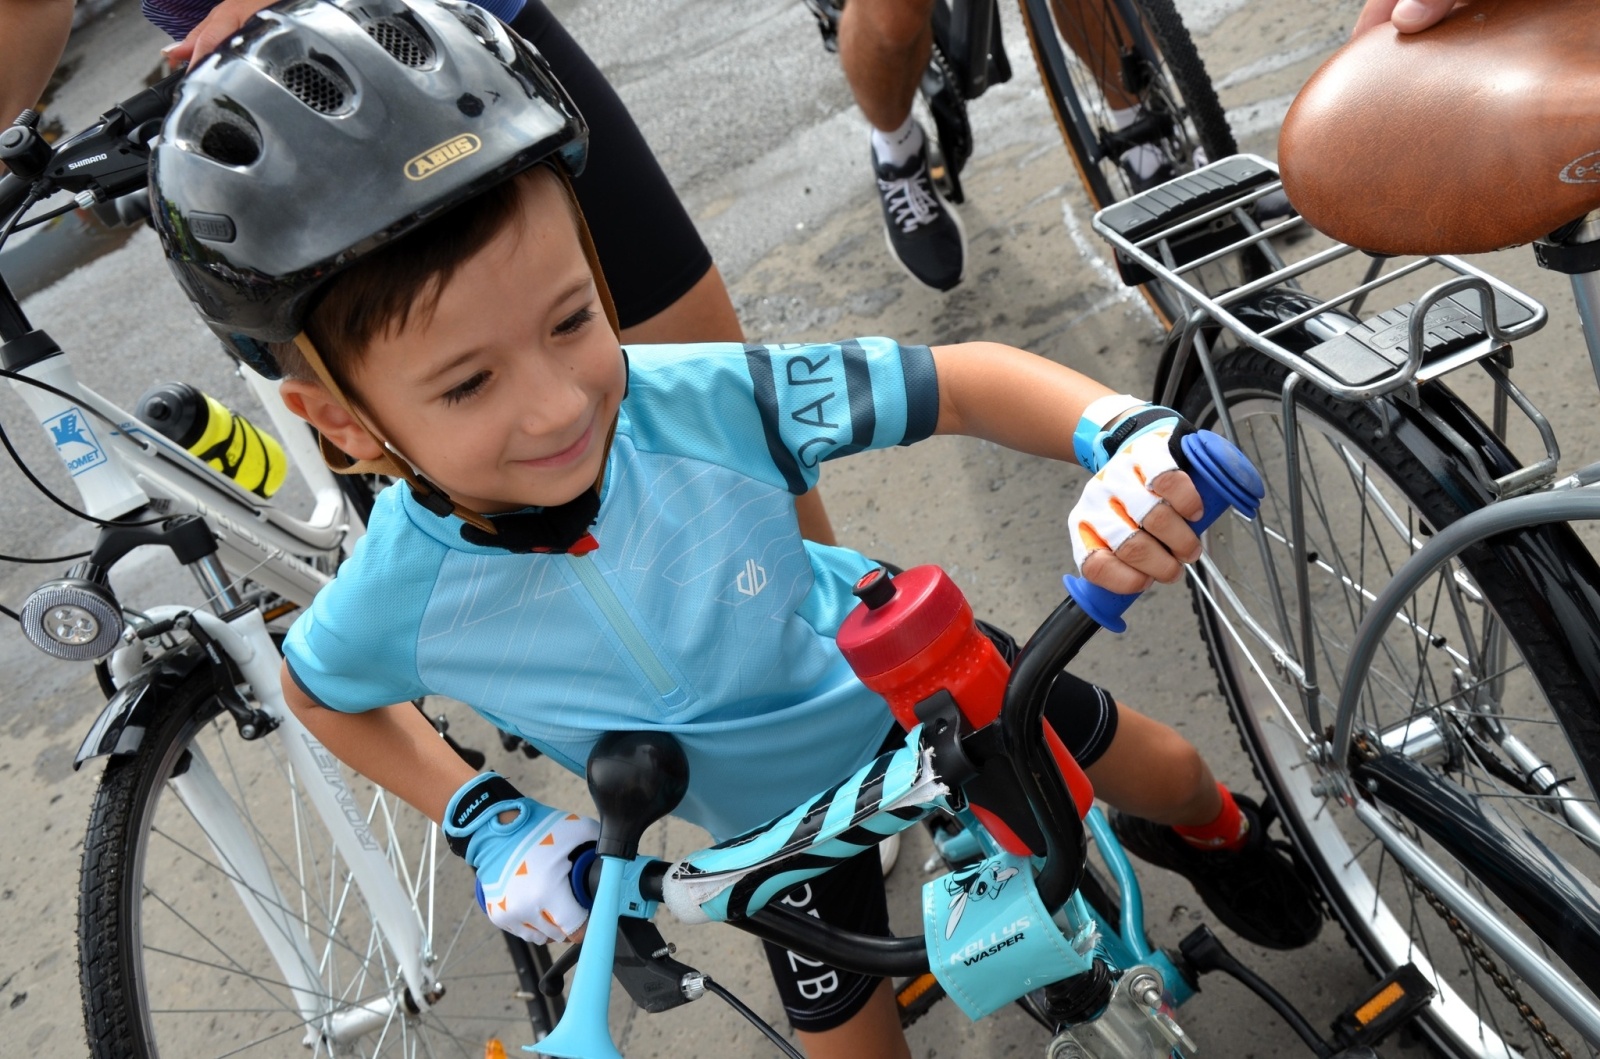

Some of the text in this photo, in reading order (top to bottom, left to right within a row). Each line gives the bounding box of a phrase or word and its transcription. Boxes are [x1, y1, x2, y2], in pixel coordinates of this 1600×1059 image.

[68, 152, 108, 170] SHIMANO
[414, 137, 474, 176] ABUS
[67, 450, 99, 471] ROMET
[300, 732, 379, 852] ROMET
[963, 931, 1025, 967] WASPER
